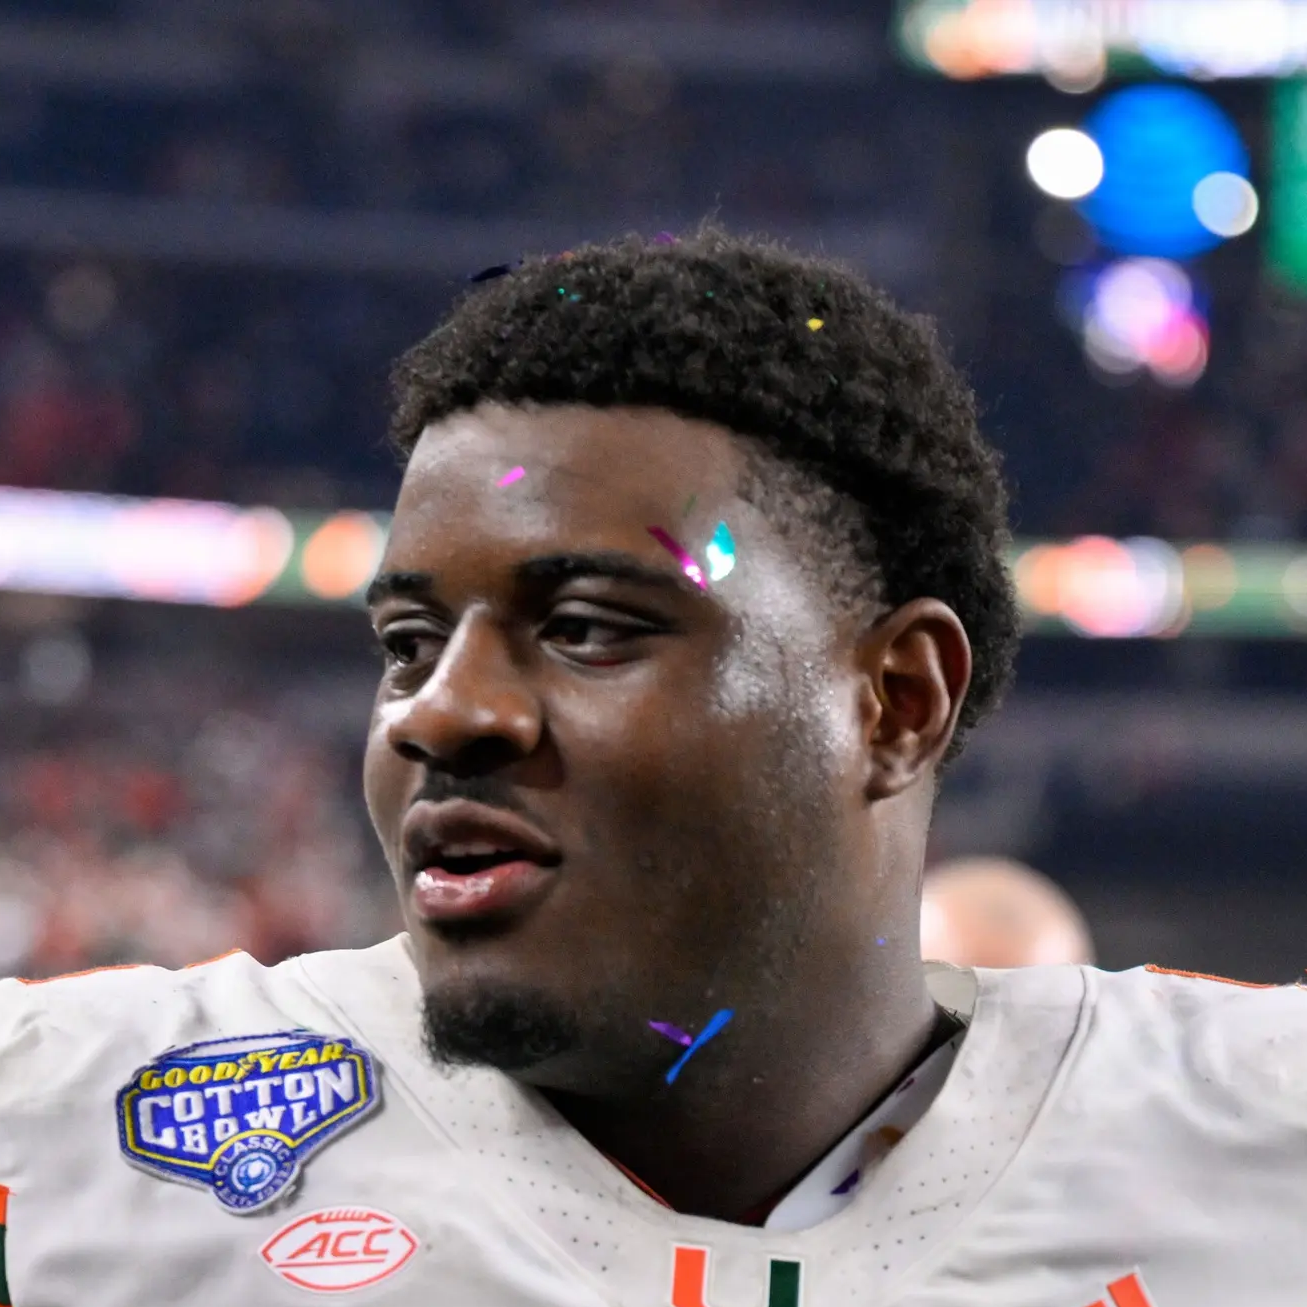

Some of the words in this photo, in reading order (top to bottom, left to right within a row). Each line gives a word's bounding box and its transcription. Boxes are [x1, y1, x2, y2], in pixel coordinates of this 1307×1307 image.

[139, 1043, 345, 1091] GOODYEAR
[137, 1061, 356, 1148] COTTON
[180, 1101, 317, 1155] BOWL
[214, 1135, 291, 1177] CLASSIC
[285, 1227, 395, 1260] ACC
